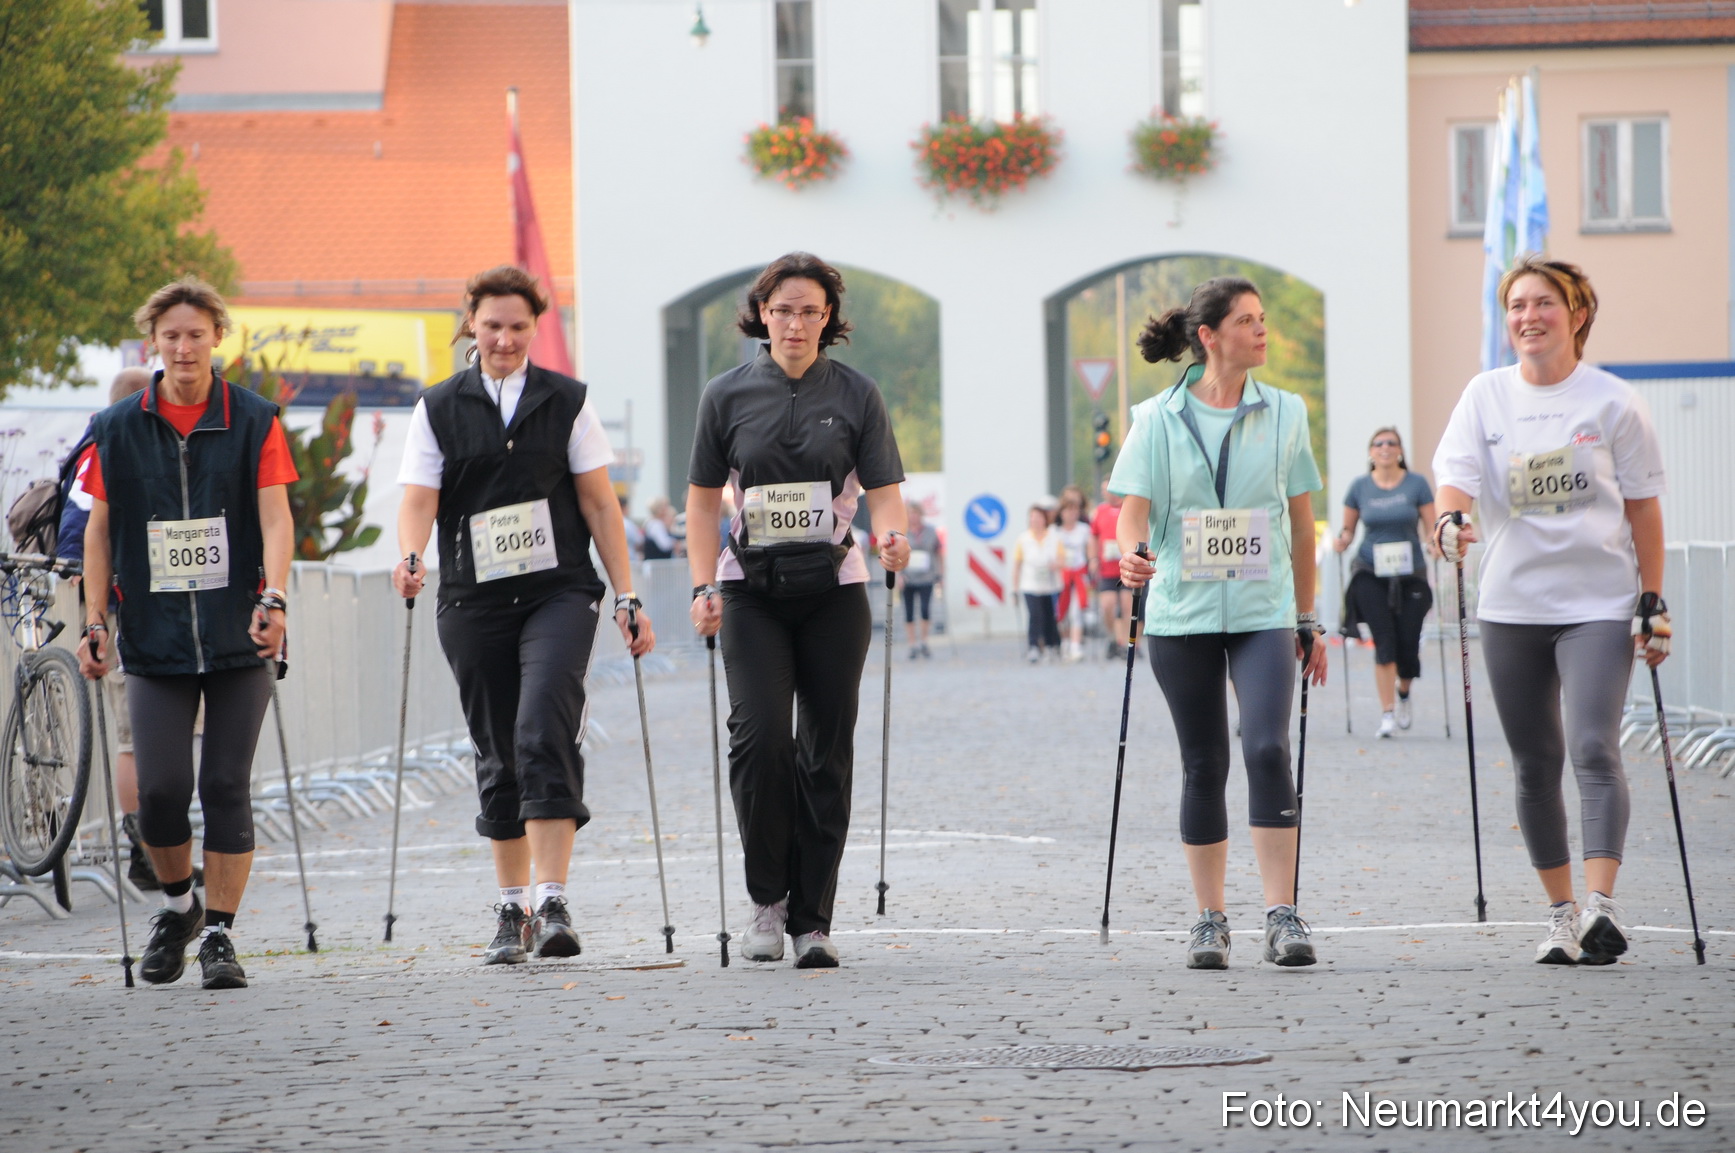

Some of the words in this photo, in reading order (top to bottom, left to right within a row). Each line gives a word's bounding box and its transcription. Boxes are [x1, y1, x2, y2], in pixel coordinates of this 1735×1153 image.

[1528, 456, 1564, 471] Karina
[1531, 472, 1588, 496] 8066
[767, 490, 805, 503] Marion
[490, 513, 520, 529] Petra
[748, 512, 755, 520] N
[770, 509, 824, 528] 8087
[1205, 515, 1236, 531] Birgit
[165, 526, 220, 542] Margareta
[495, 528, 546, 553] 8086
[1207, 537, 1262, 556] 8085
[169, 545, 221, 567] 8083
